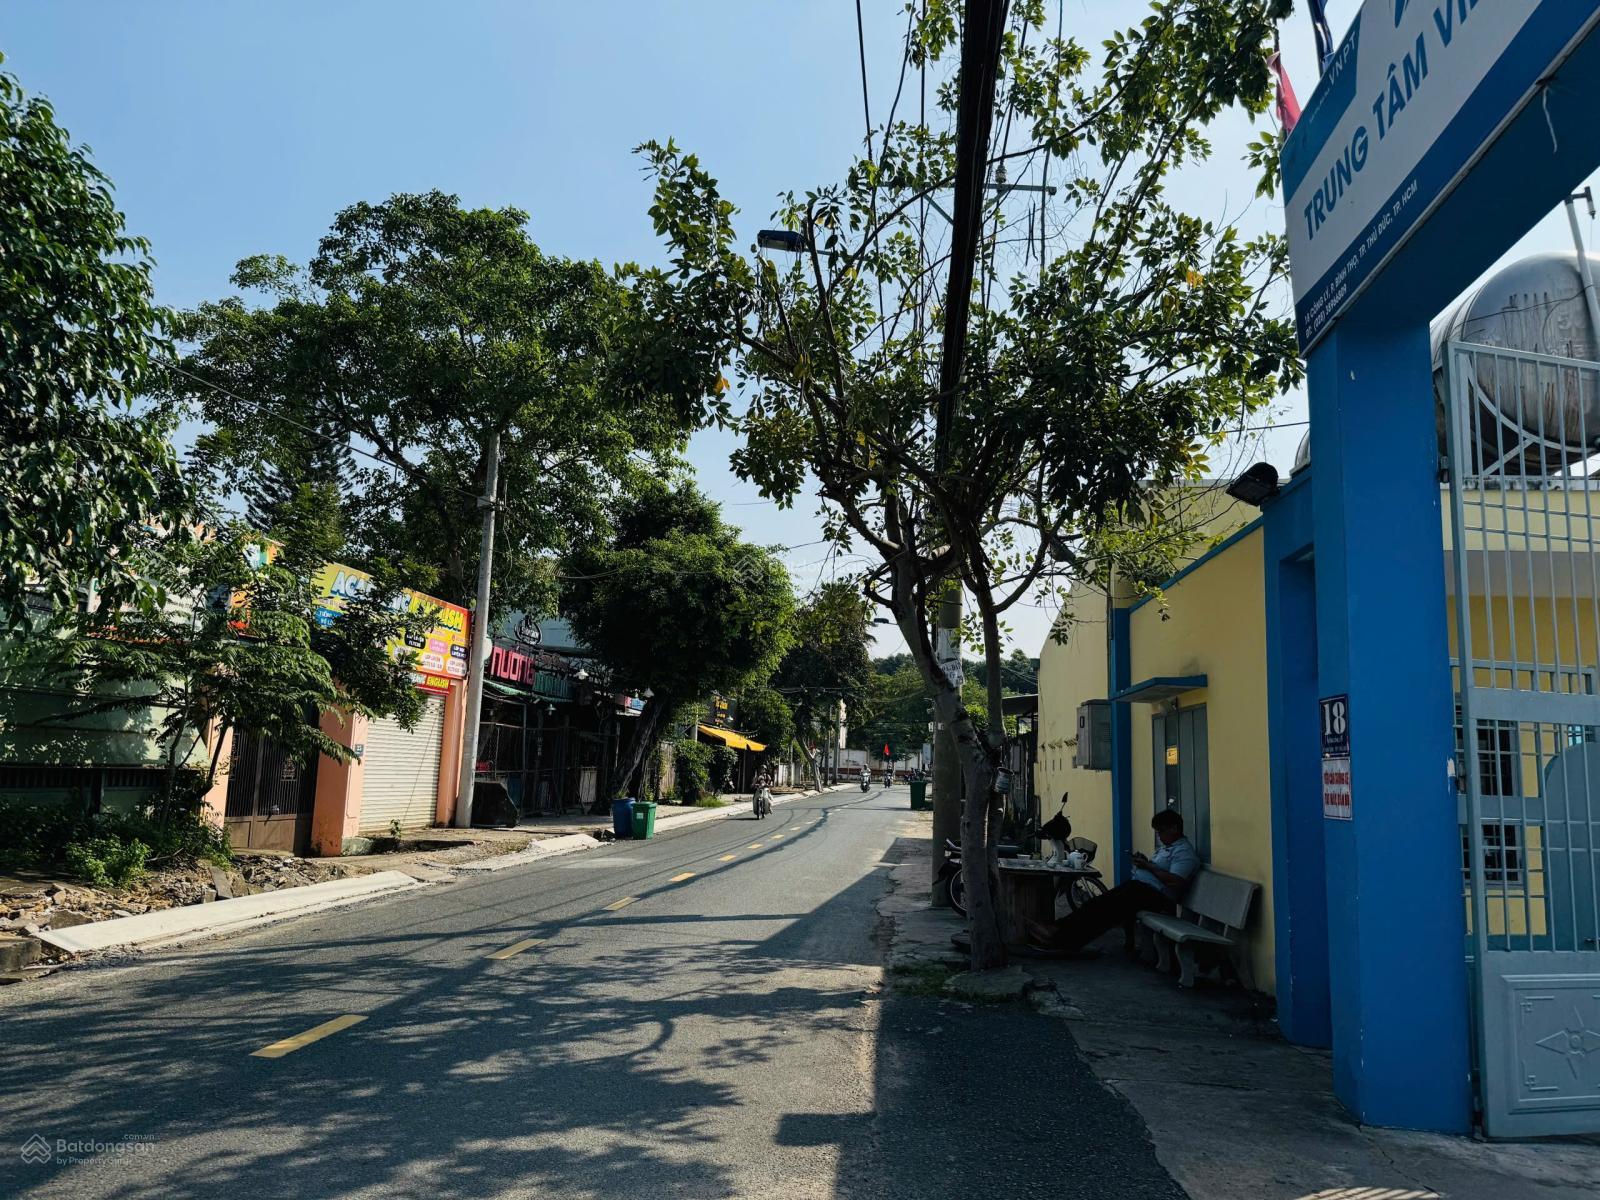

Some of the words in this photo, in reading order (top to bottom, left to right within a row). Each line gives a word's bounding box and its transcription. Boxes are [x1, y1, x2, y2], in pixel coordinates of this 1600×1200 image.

[1328, 32, 1355, 86] VNPT
[1304, 126, 1368, 240] TRUNG
[1373, 32, 1429, 140] TÂM
[1401, 179, 1418, 207] HCM
[1323, 701, 1346, 735] 18
